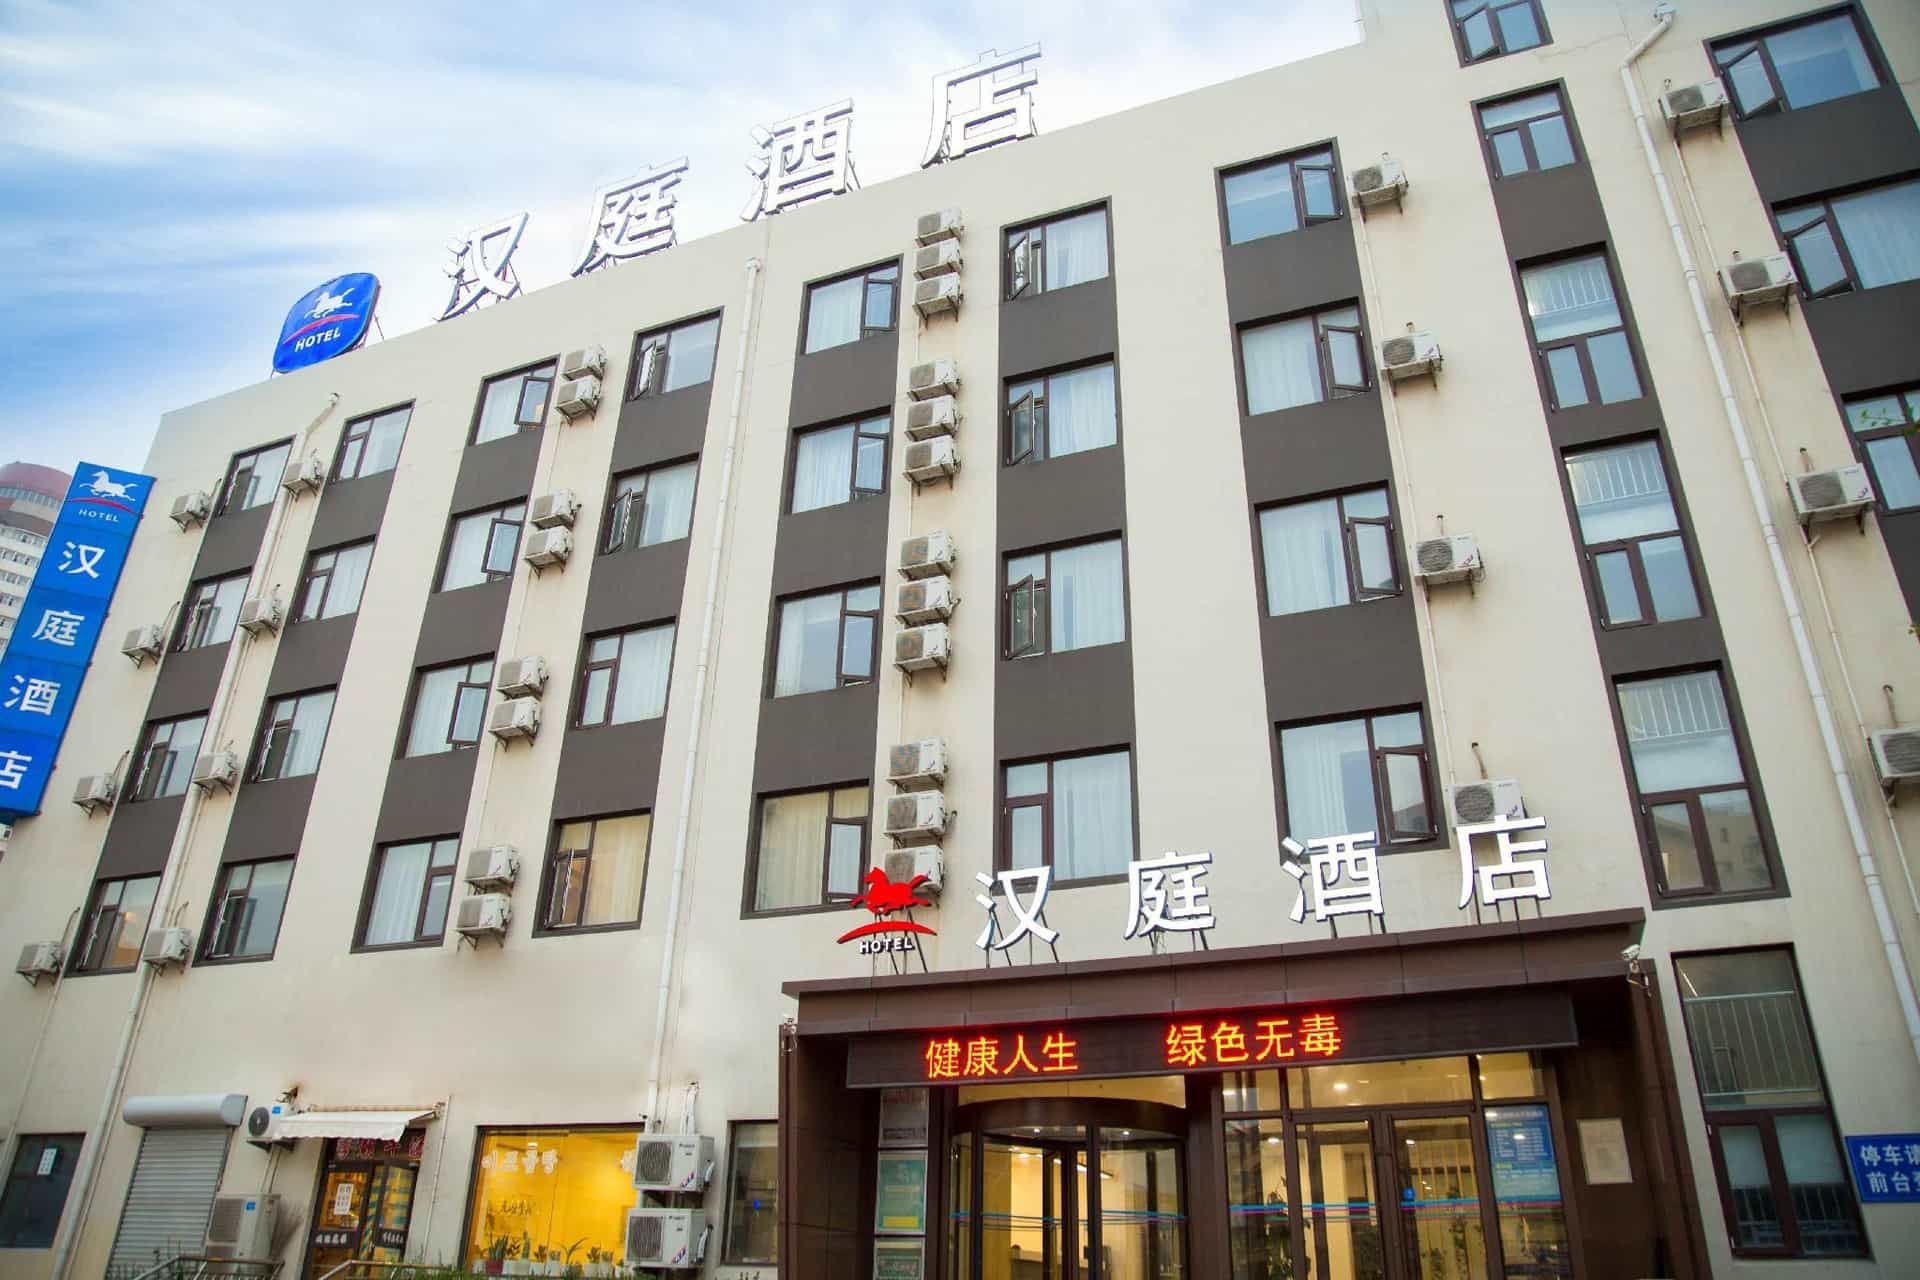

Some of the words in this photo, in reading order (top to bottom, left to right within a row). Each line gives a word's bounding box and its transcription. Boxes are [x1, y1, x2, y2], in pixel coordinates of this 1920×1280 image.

[438, 42, 1043, 321] 汉庭酒店
[294, 327, 341, 352] HOTEL
[78, 508, 120, 523] HOTEL
[0, 541, 106, 789] 汉庭酒店
[975, 814, 1552, 950] 汉庭酒店
[859, 937, 915, 955] HOTEL
[925, 1031, 1078, 1079] 健康人生
[1165, 1013, 1342, 1067] 绿色无毒
